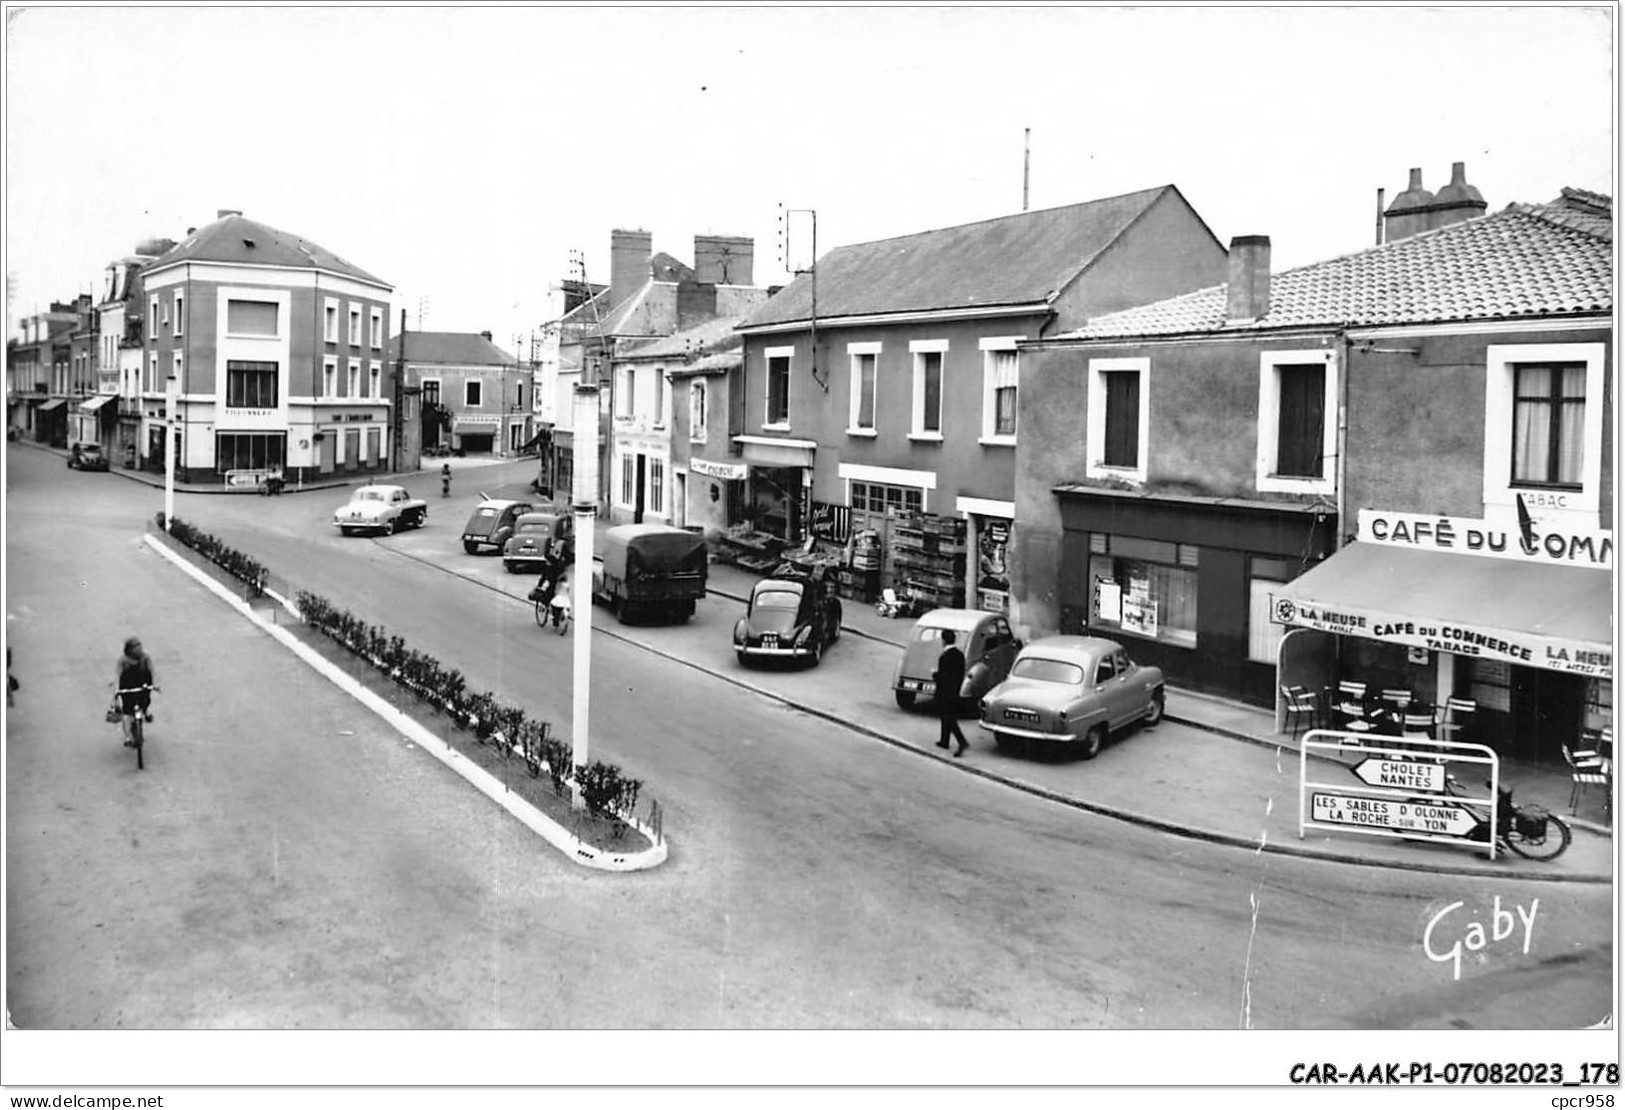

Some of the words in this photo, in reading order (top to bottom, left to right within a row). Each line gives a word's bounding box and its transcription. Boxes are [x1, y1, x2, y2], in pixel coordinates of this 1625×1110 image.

[1371, 518, 1455, 547] CAFÉ
[1467, 529, 1507, 551] DU
[1300, 608, 1318, 620] LA
[1322, 610, 1366, 628] MEUSE
[1373, 622, 1415, 637] CAFÉ
[1442, 626, 1533, 661] COMMERCE
[1546, 645, 1569, 662] LA
[1381, 762, 1432, 777] CHOLET
[1380, 775, 1432, 788] NANTES
[1316, 797, 1337, 808] LES
[1346, 800, 1389, 813] SABLES
[1329, 810, 1344, 821] LA
